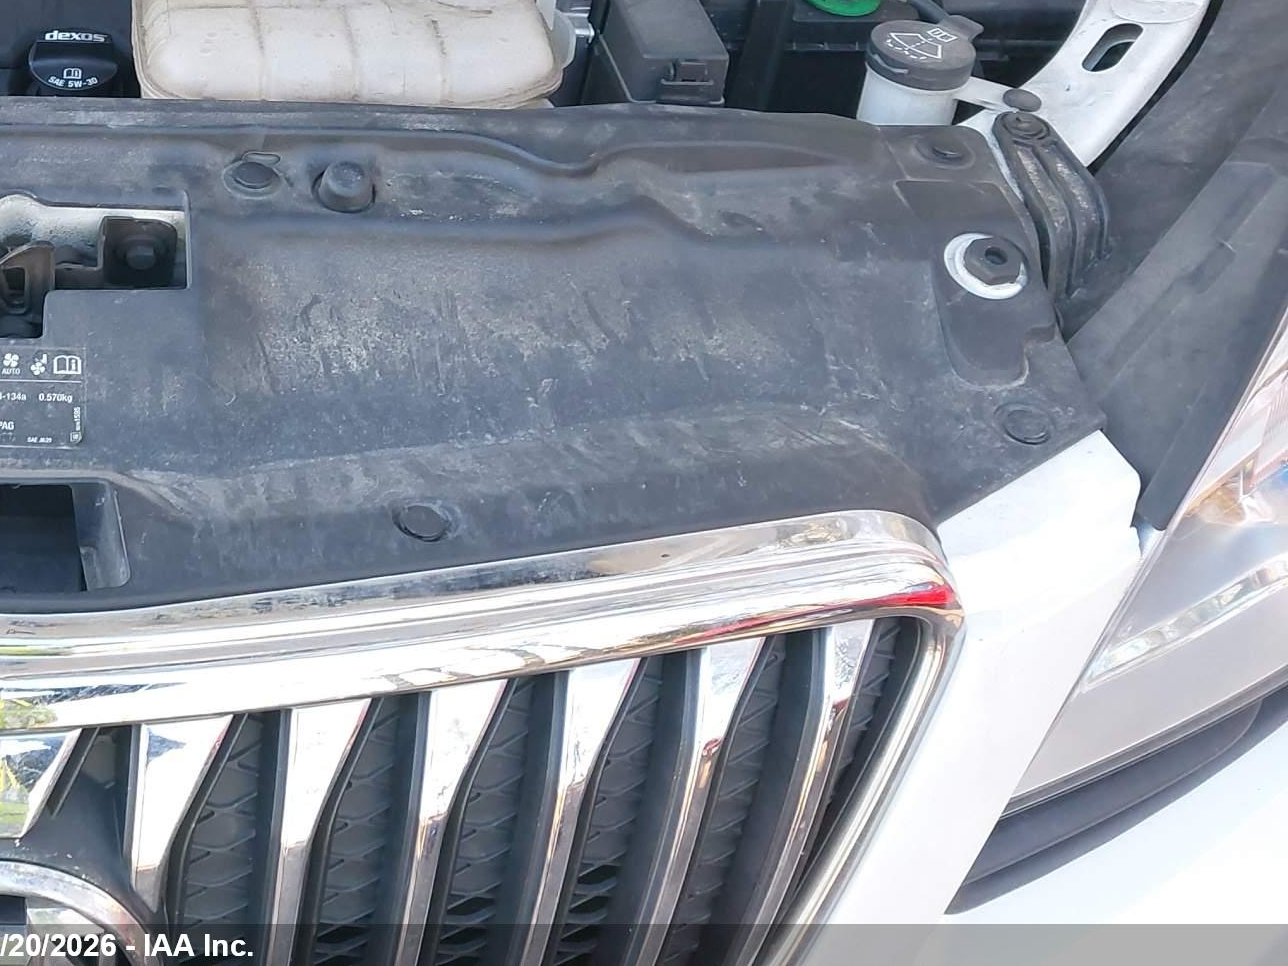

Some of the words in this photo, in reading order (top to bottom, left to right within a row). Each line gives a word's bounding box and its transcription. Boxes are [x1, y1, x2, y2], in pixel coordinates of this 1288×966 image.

[45, 30, 108, 42] dexos
[48, 76, 65, 86] SAE
[68, 77, 98, 87] 5W-30
[38, 392, 73, 404] 0.570kg
